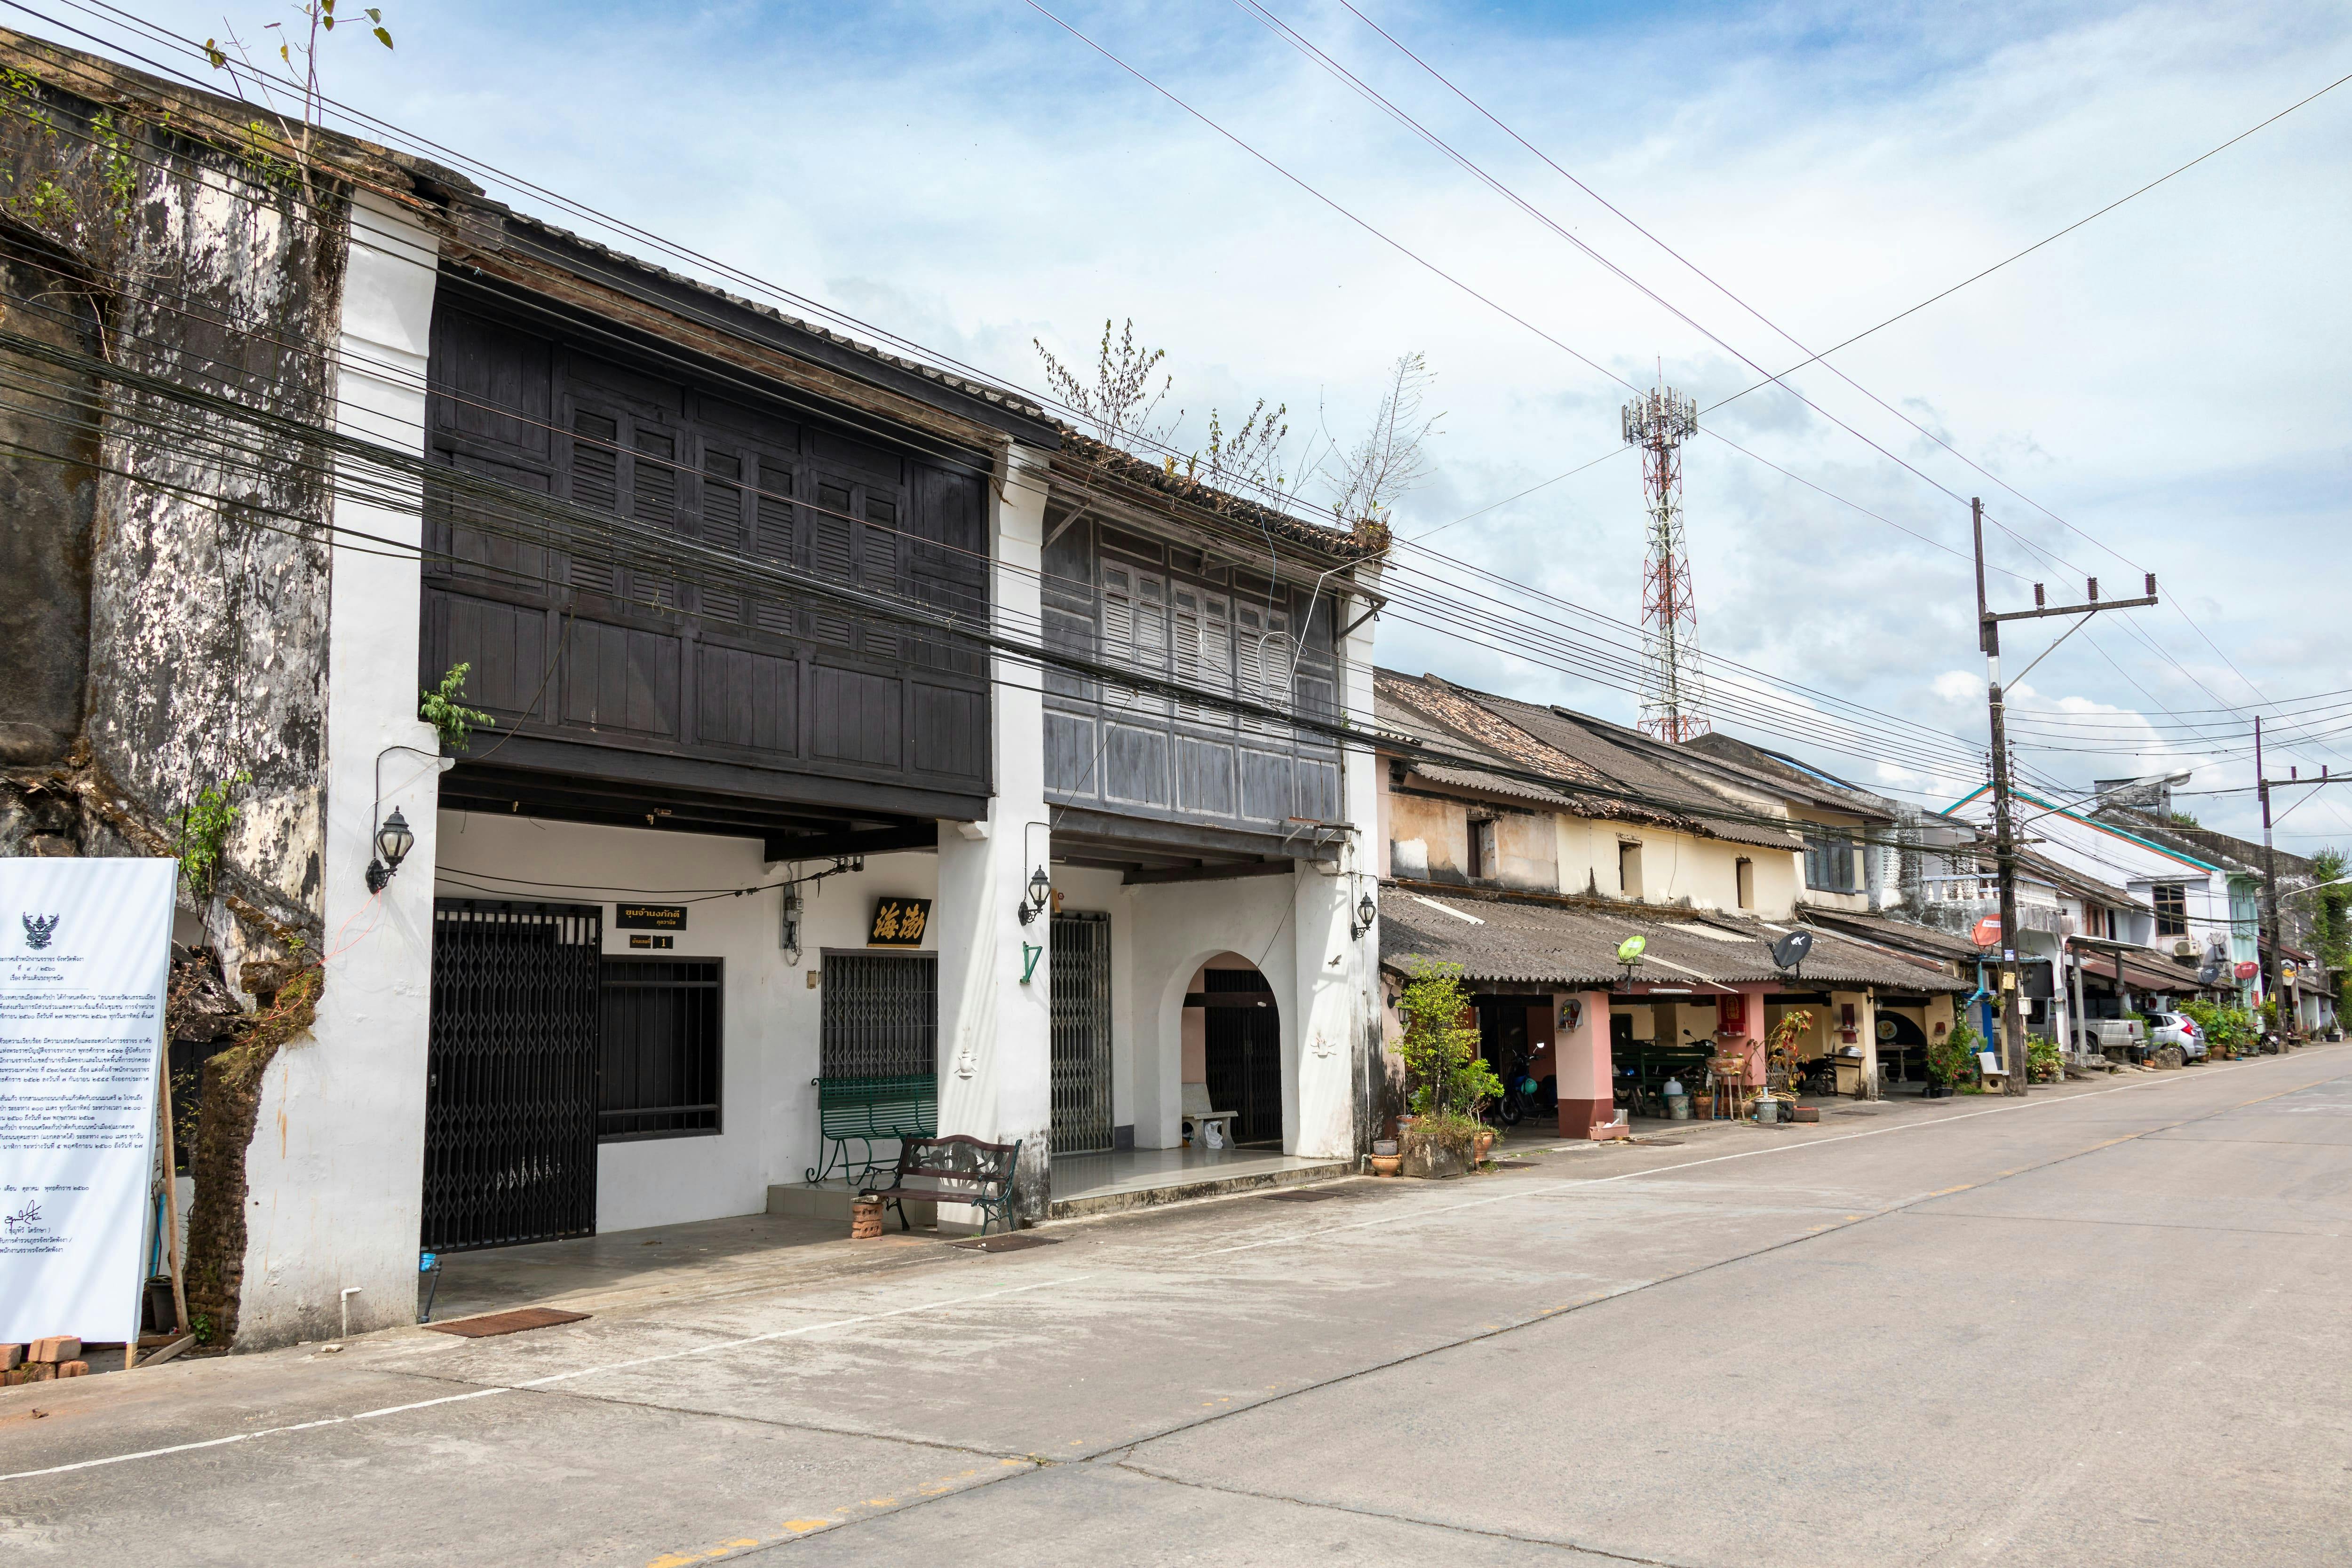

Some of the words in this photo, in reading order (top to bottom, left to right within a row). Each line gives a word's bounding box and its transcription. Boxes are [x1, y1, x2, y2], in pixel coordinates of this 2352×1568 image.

[625, 908, 680, 918] ขุนจำนงภักดี
[661, 938, 666, 947] 1
